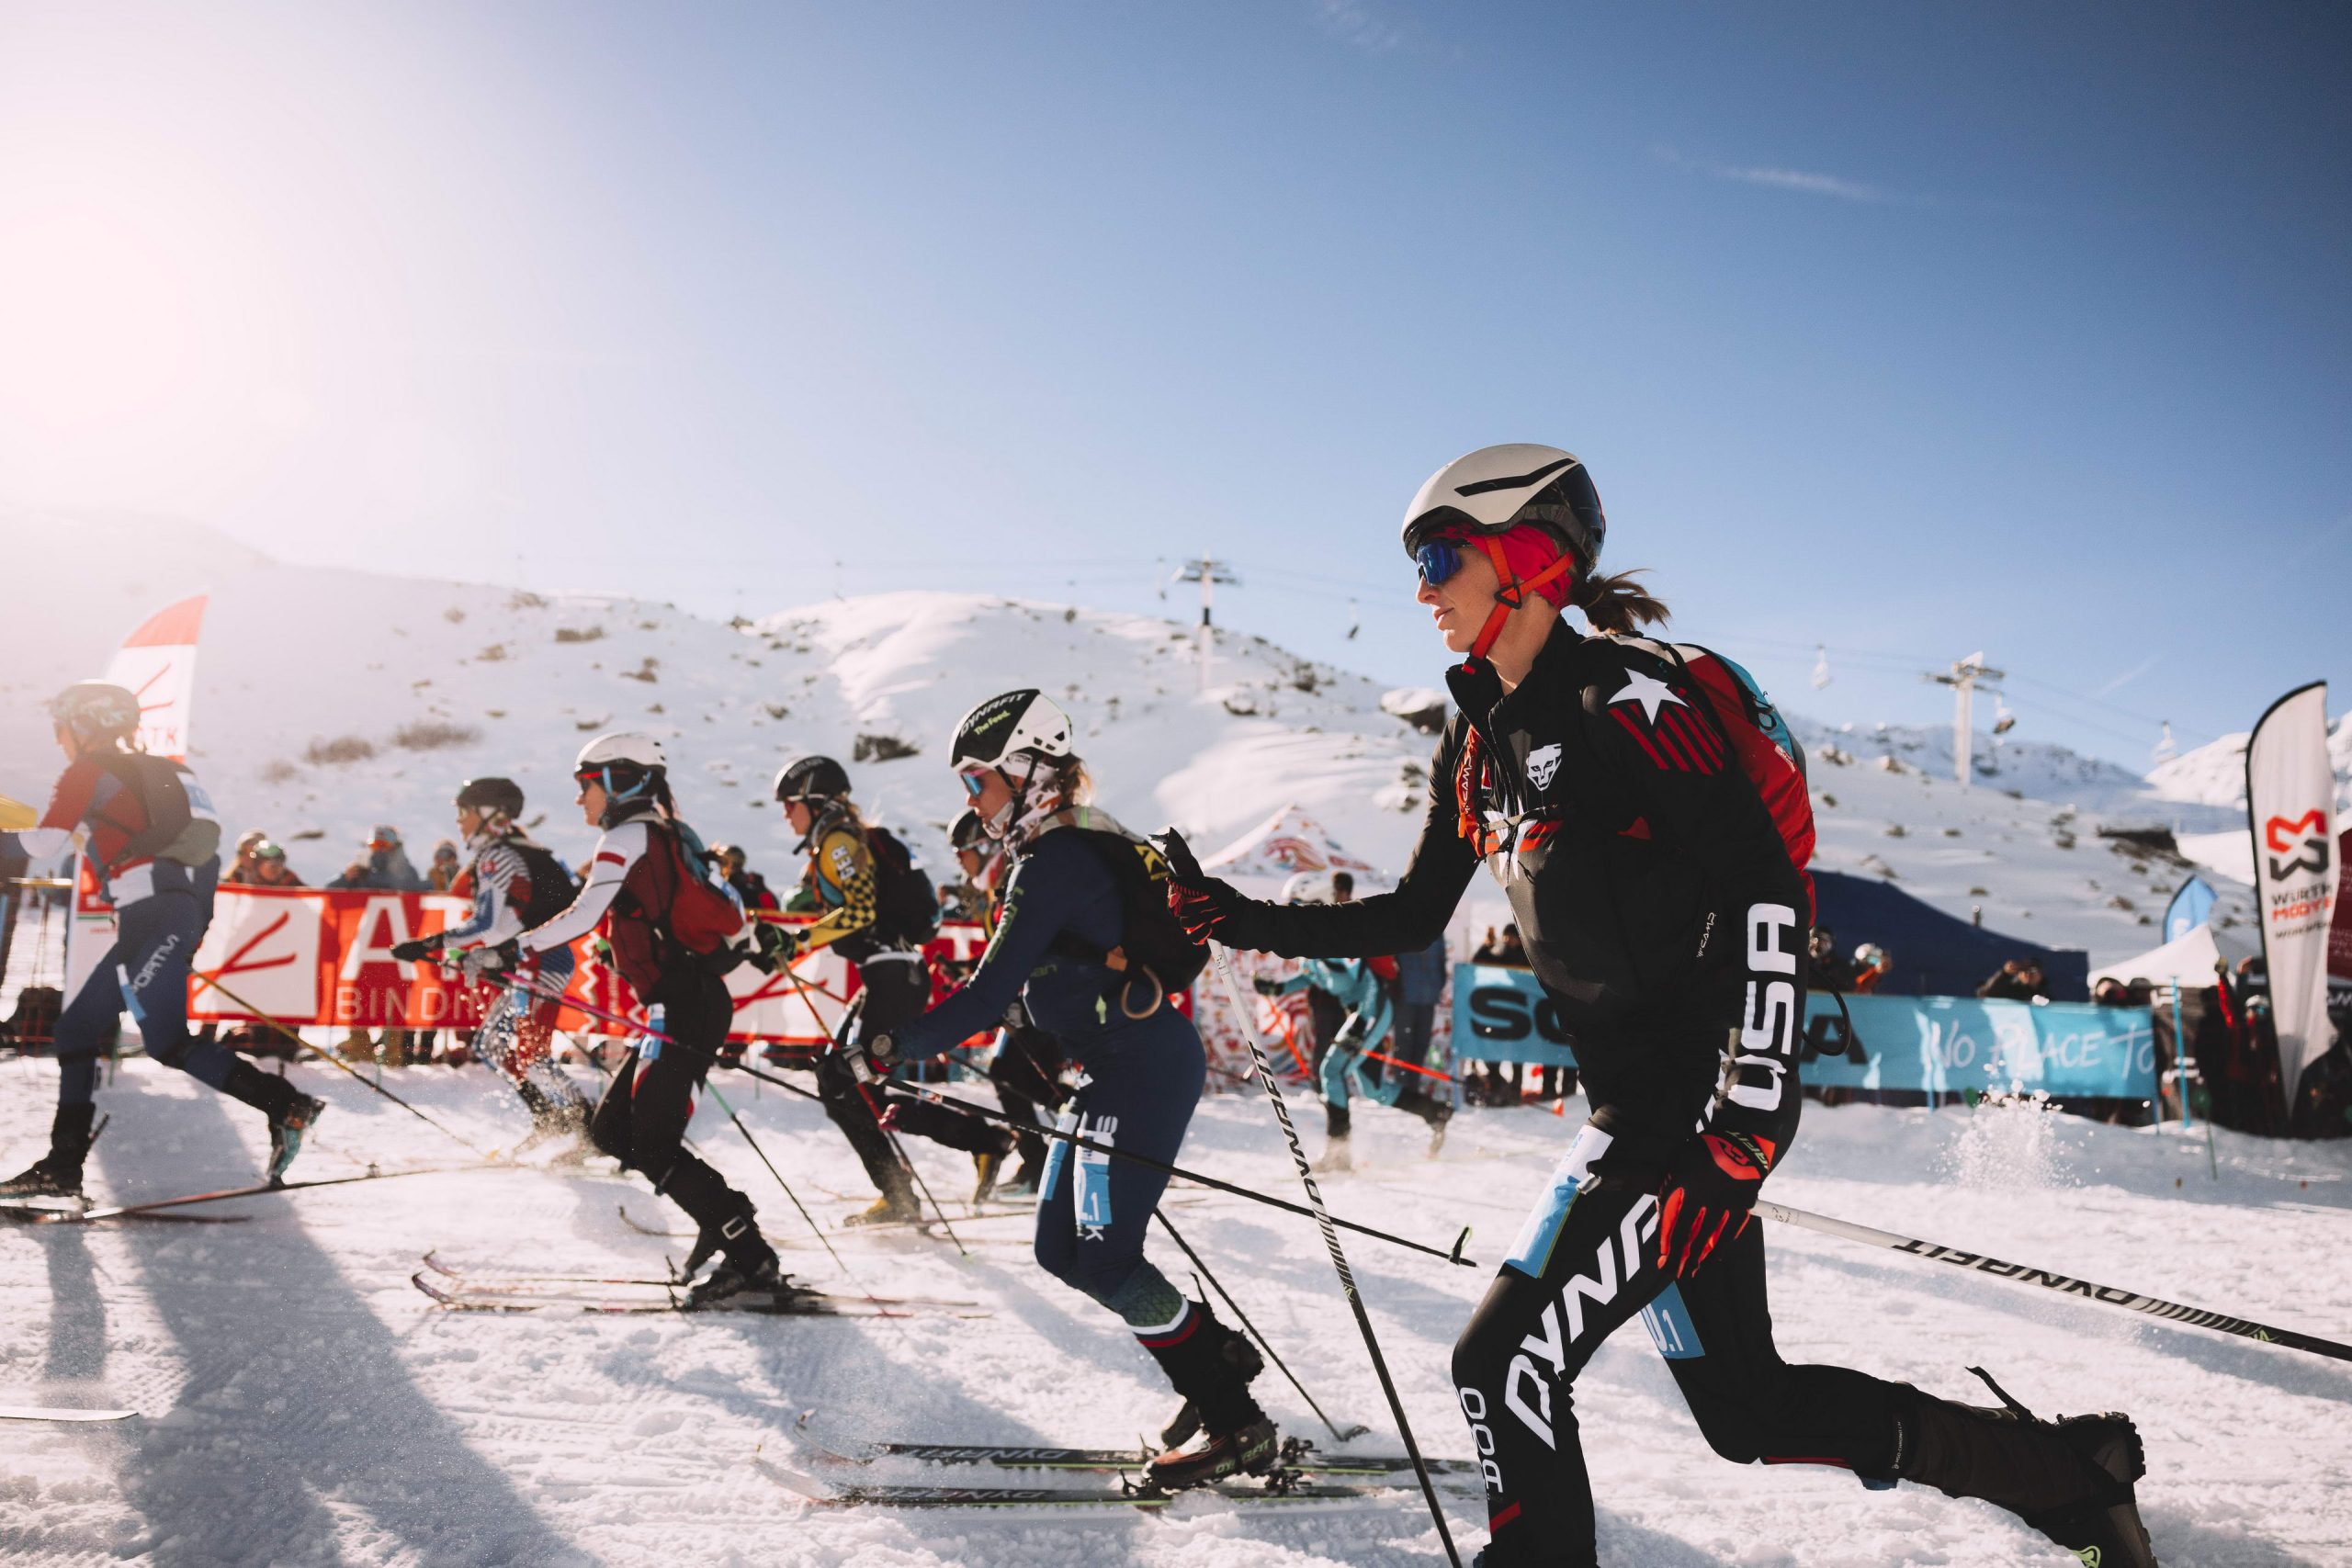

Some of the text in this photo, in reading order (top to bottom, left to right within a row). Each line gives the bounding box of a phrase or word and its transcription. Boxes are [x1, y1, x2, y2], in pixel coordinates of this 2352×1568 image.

[960, 693, 1026, 738] DYNAFIT
[831, 845, 855, 880] GER
[132, 933, 180, 993] ORTIVA
[340, 896, 474, 981] AT
[1727, 903, 1795, 1111] USA
[1247, 1040, 1323, 1206] DYNAFIT
[1892, 1239, 2141, 1305] DYNAFIT
